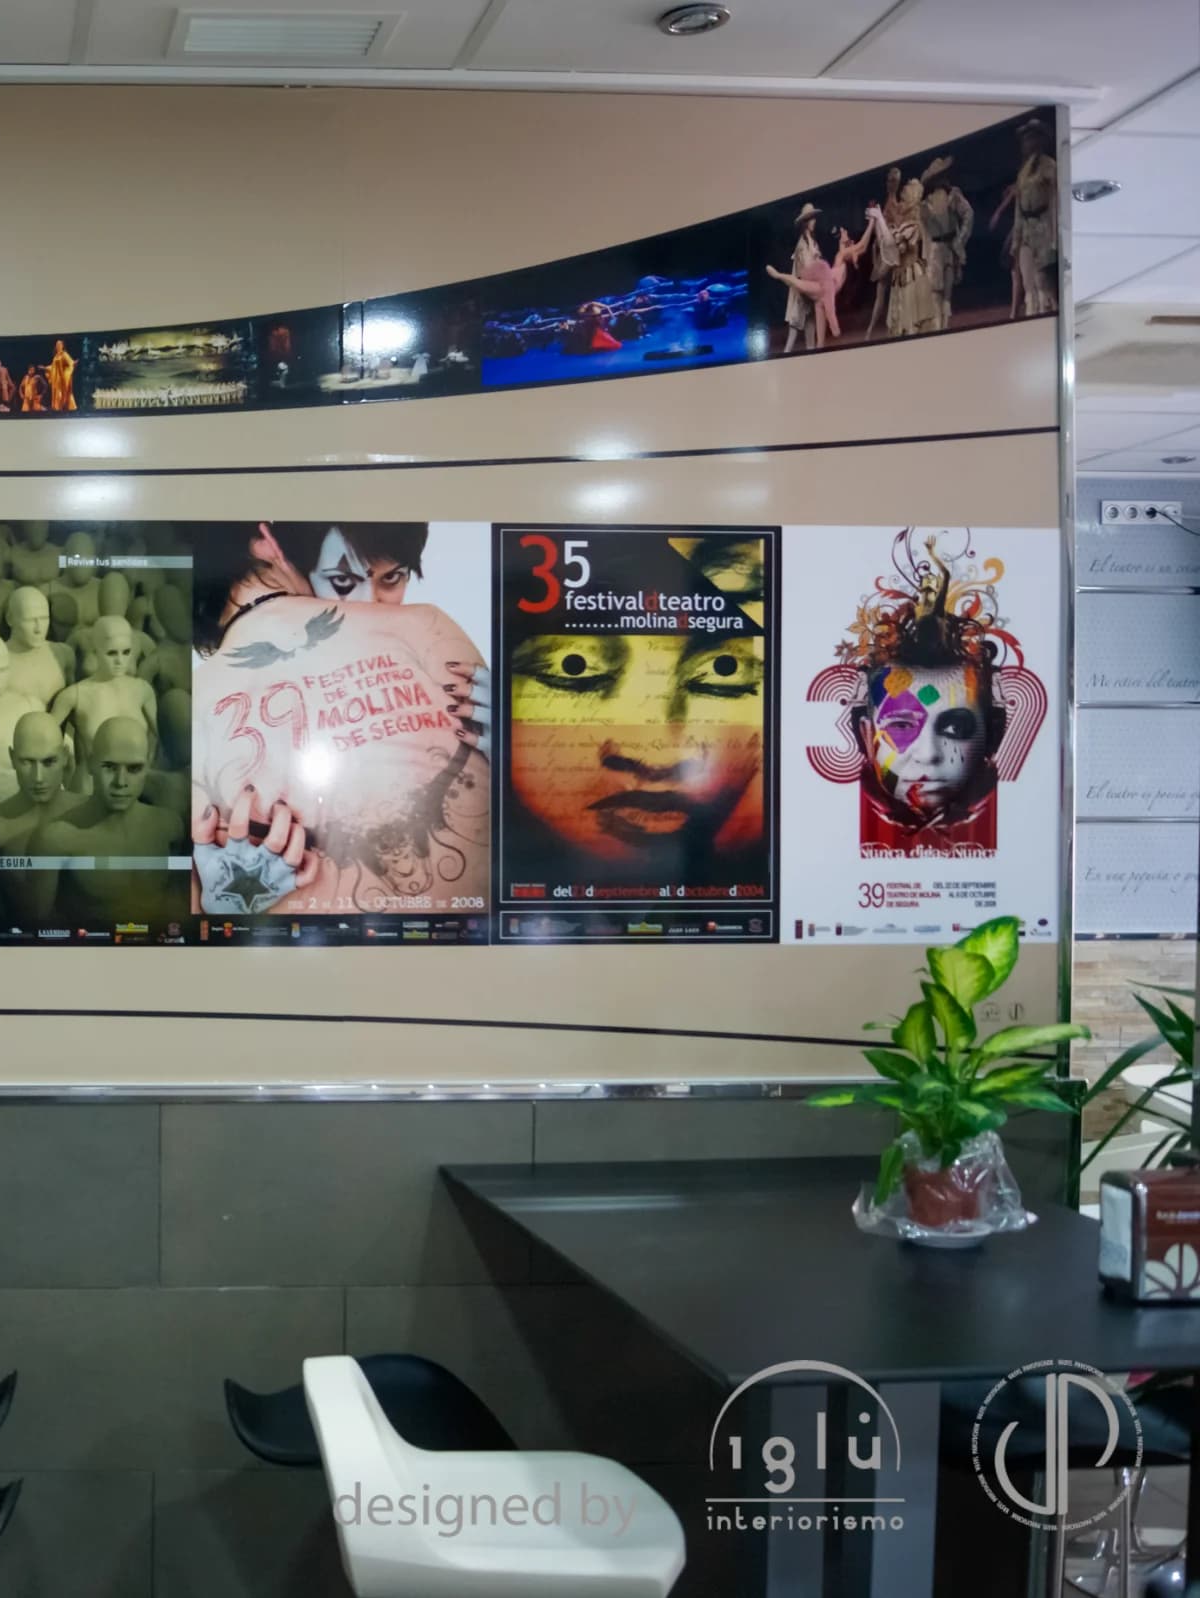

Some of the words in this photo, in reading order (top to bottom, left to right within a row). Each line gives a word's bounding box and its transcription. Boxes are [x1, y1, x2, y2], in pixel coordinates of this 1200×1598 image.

[302, 654, 399, 690] FESTIVAL
[323, 687, 347, 705] DE
[354, 667, 415, 690] TEATRO
[317, 682, 433, 730] MOLINA
[214, 680, 311, 781] 39
[332, 727, 368, 752] DE
[368, 709, 453, 741] SEGURA
[451, 896, 485, 909] 2008
[858, 882, 886, 908] 39
